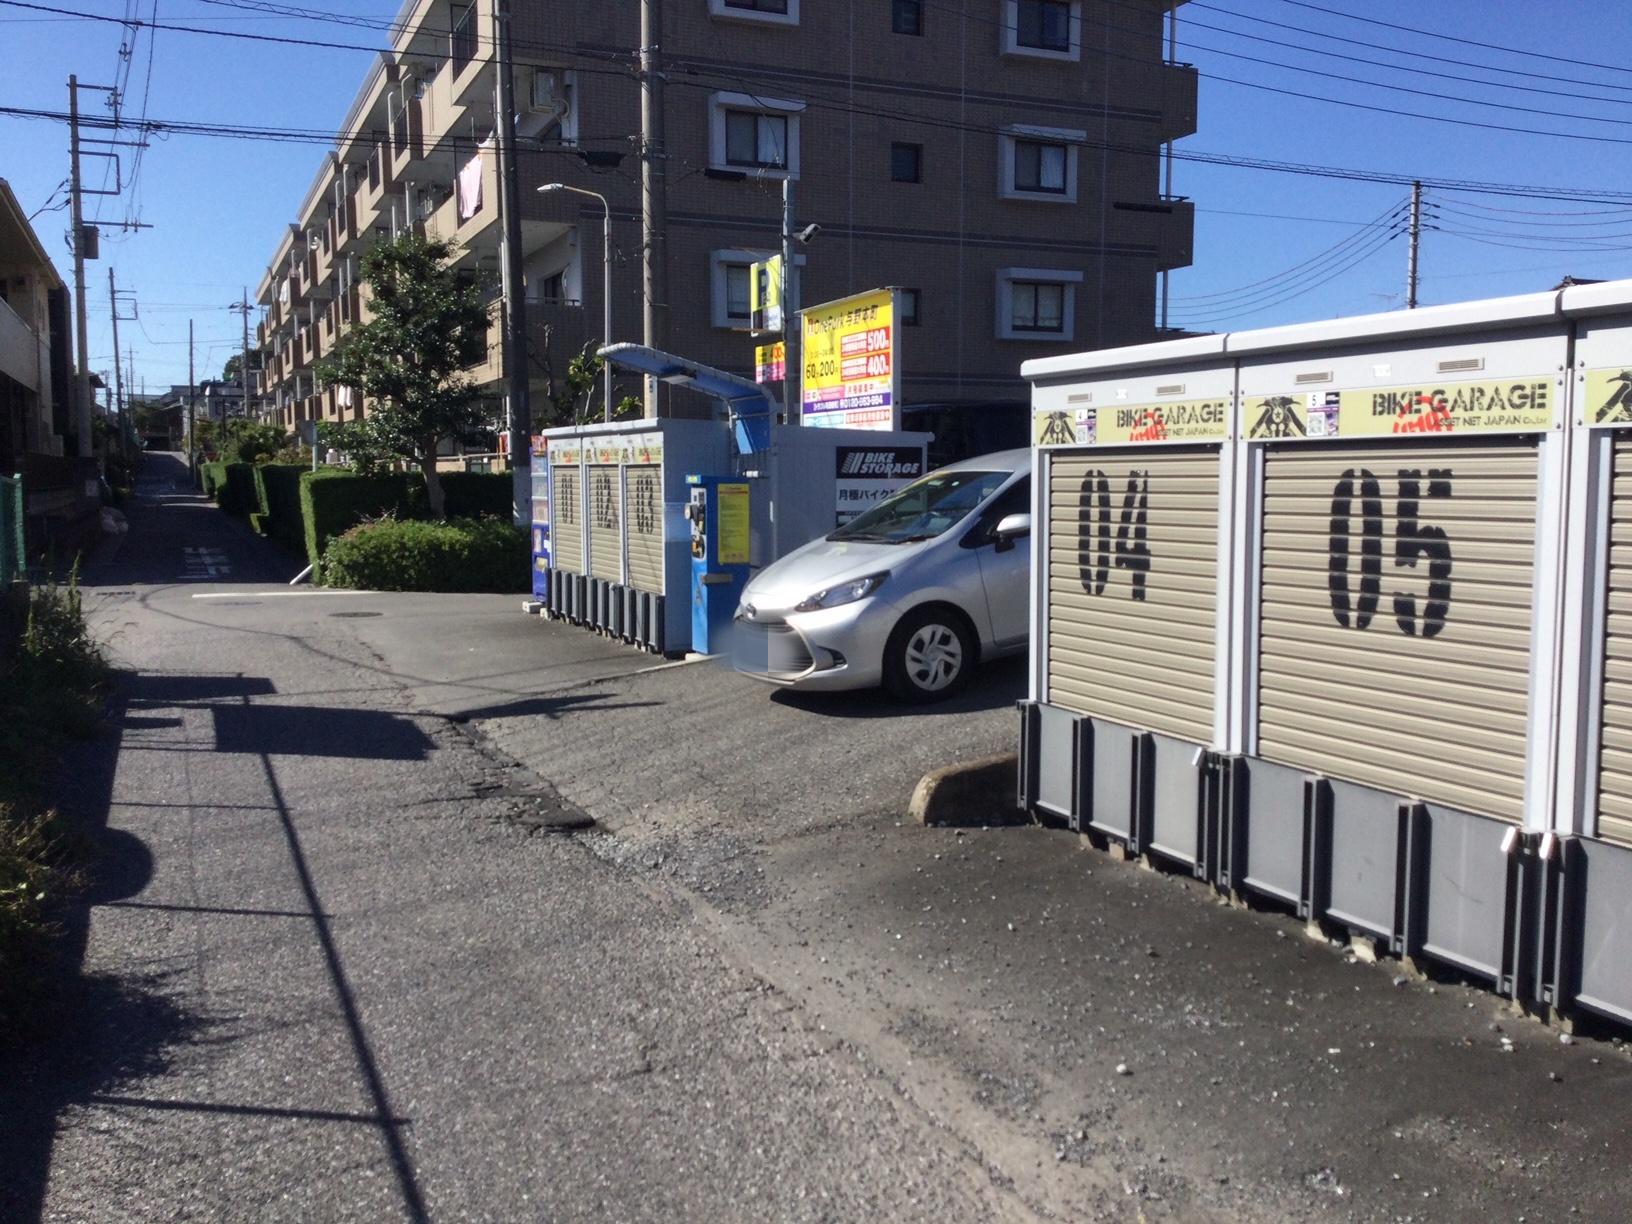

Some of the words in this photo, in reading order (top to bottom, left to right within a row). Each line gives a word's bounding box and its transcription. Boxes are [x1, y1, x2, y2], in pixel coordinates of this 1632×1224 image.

[1372, 391, 1423, 416] BIKE
[1431, 383, 1547, 412] GARAGE
[1117, 408, 1148, 428] BIKE
[1153, 402, 1224, 426] GARAGE
[1484, 415, 1521, 426] JAPAN
[860, 463, 920, 474] STORAGE
[864, 452, 895, 463] BIKE
[596, 474, 611, 529] 02
[636, 474, 654, 535] 03
[839, 489, 895, 501] 月極バイク
[1078, 469, 1151, 601] 04
[1329, 468, 1452, 638] 05
